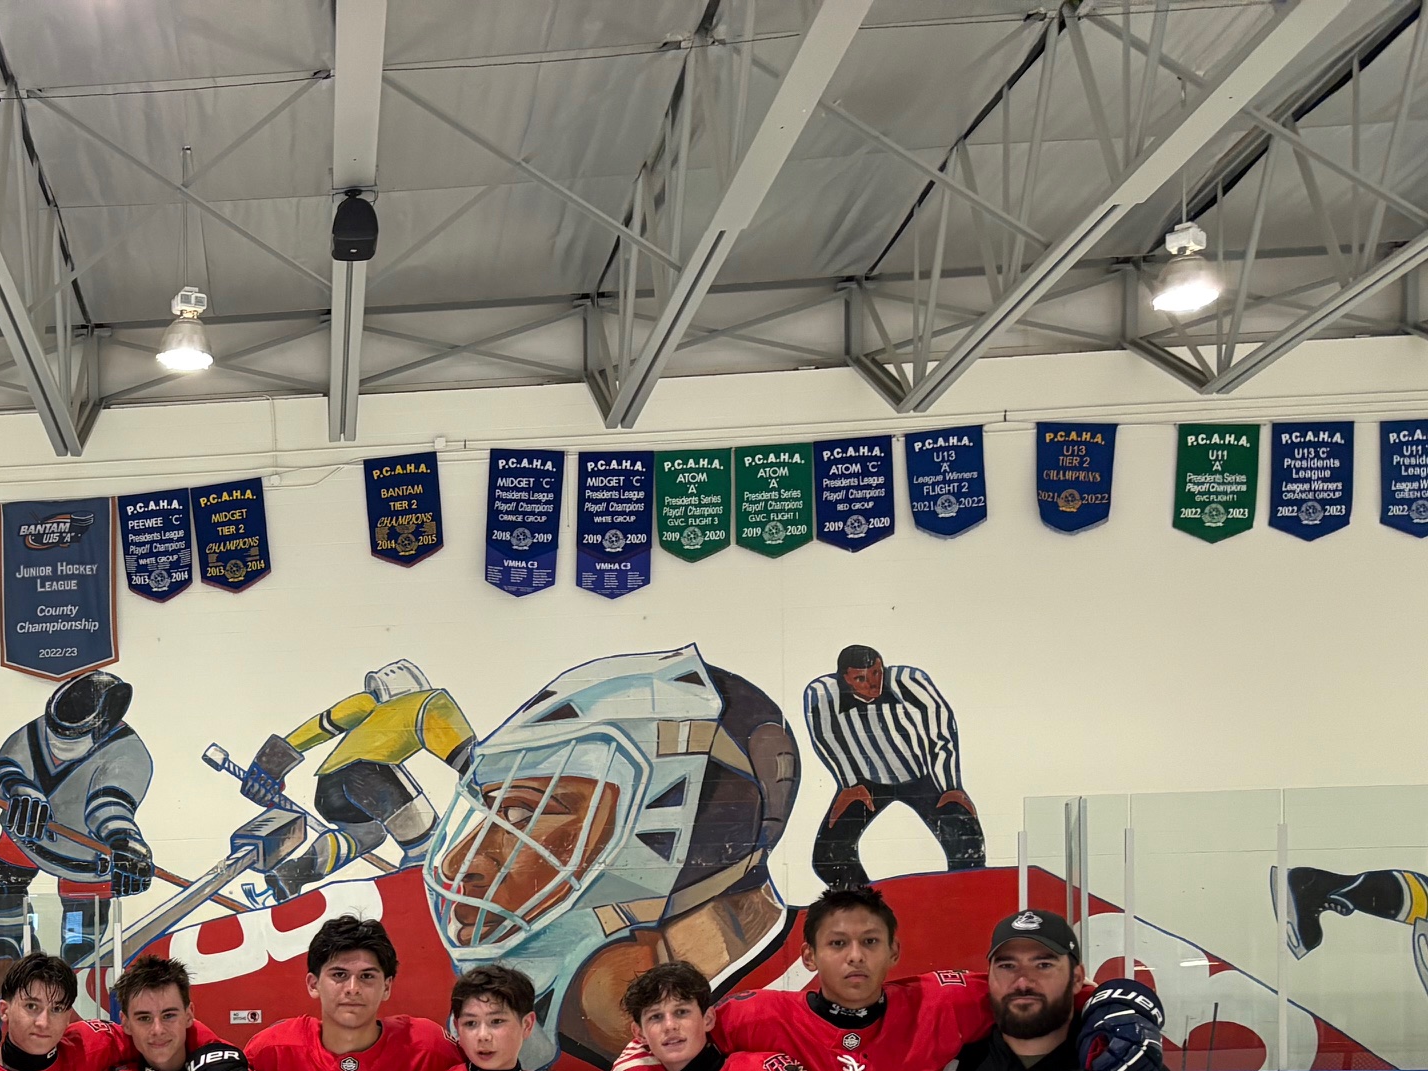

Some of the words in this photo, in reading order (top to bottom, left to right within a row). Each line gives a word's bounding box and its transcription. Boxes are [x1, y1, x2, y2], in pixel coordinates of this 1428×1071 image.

[914, 436, 973, 452] P.C.A.H.A.
[1046, 432, 1105, 444] P.C.A.H.A.
[1187, 434, 1250, 447] P.C.A.H.A.
[1281, 432, 1345, 445] P.C.A.H.A.
[822, 446, 884, 461] P.C.A.H.A.
[933, 451, 956, 462] U13
[1063, 446, 1085, 455] U13
[1209, 450, 1227, 460] U11
[1294, 448, 1315, 458] U13
[498, 459, 556, 472] P.C.A.H.A.
[587, 460, 646, 472] P.C.A.H.A.
[664, 458, 723, 472] P.C.A.H.A.
[744, 453, 805, 467] P.C.A.H.A.
[1058, 457, 1079, 466] TIER
[1083, 458, 1090, 466] 2
[372, 463, 430, 480] P.C.A.H.A.
[757, 467, 789, 478] ATOM
[829, 463, 861, 475] ATOM
[497, 478, 534, 488] MIDGET
[586, 477, 624, 487] MIDGET
[676, 473, 707, 483] ATOM
[381, 485, 423, 498] BANTAM
[924, 483, 959, 495] FLIGHT
[961, 482, 968, 492] 2
[200, 490, 256, 507] P.C.A.H.A.
[959, 496, 985, 507] 2022
[127, 499, 183, 515] P.C.A.H.A.
[389, 501, 408, 511] TIER
[411, 500, 417, 509] 2
[1277, 506, 1298, 517] 2022
[1325, 505, 1345, 516] 2023
[211, 509, 247, 523] MIDGET
[1180, 508, 1201, 518] 2022
[1227, 508, 1248, 518] 2023
[128, 517, 164, 529] PEEWEE
[377, 512, 433, 527] CHAMPIONS
[824, 521, 843, 532] 2019
[869, 517, 890, 527] 2020
[19, 523, 70, 535] BANTAM
[217, 525, 233, 535] TIER
[236, 524, 245, 534] 2
[742, 527, 762, 537] 2019
[786, 525, 807, 536] 2020
[43, 533, 60, 543] U15
[492, 530, 511, 541] 2018
[533, 533, 552, 543] 2019
[583, 534, 602, 544] 2019
[626, 534, 647, 544] 2020
[662, 531, 680, 542] 2019
[704, 530, 725, 540] 2020
[377, 540, 395, 550] 2014
[418, 535, 436, 545] 2015
[503, 560, 526, 568] VMHA
[595, 562, 619, 570] VMHA
[37, 605, 79, 618] County
[16, 619, 99, 634] Championship
[39, 648, 78, 658] 2022/23
